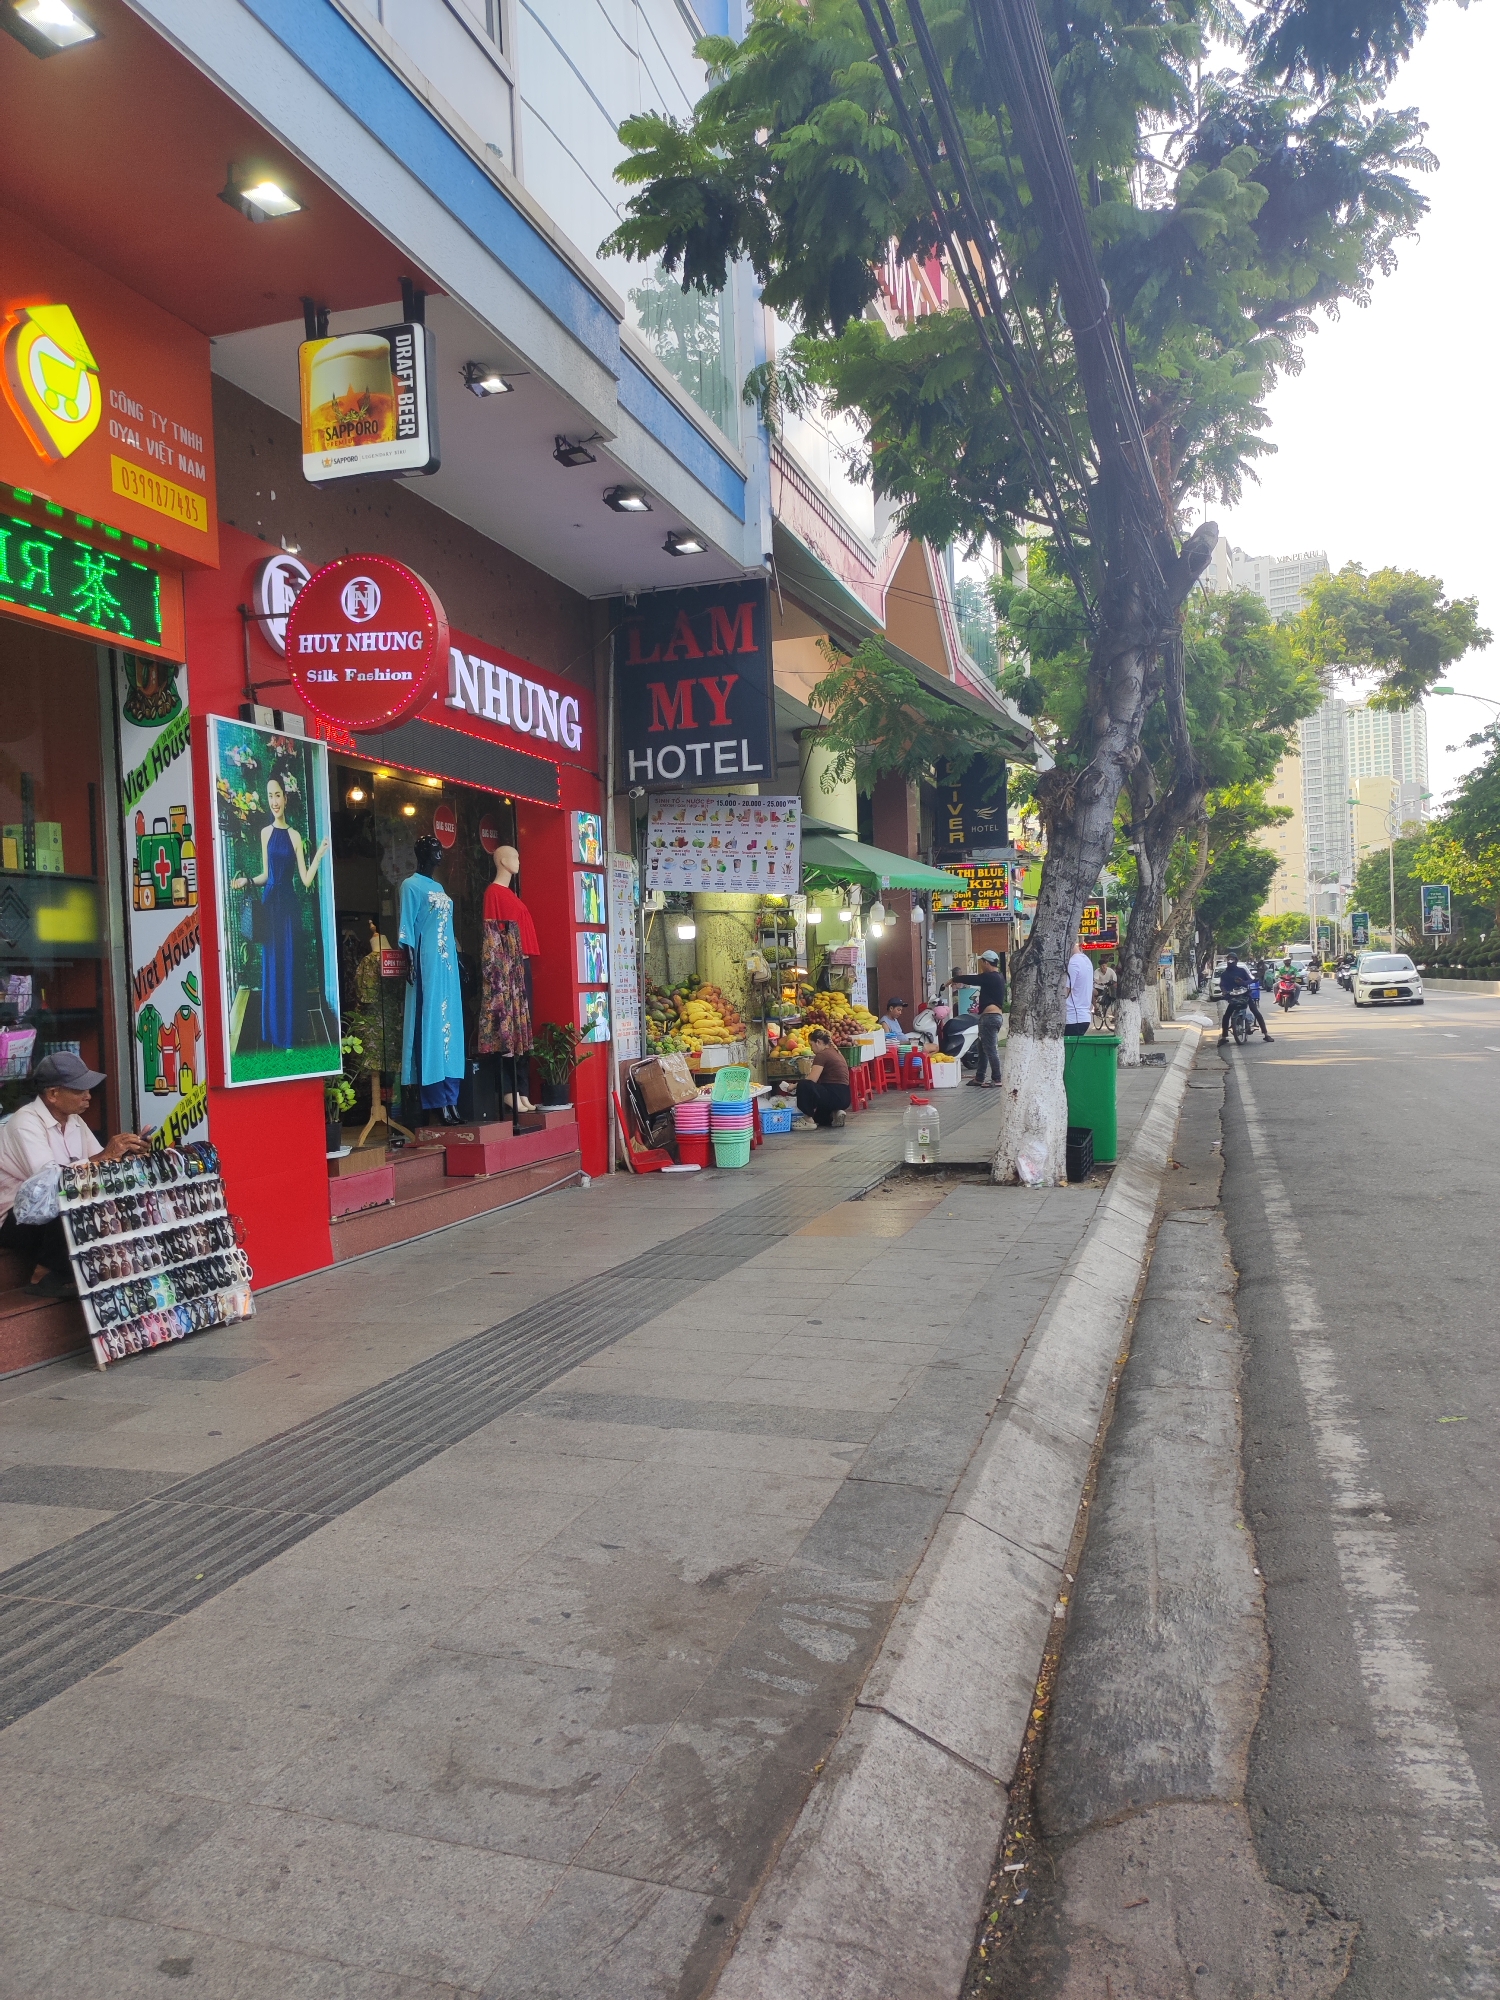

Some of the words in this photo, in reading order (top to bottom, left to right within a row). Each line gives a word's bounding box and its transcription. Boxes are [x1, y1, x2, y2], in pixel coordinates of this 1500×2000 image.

[395, 333, 414, 388] DRAFT
[109, 389, 145, 422] CÔNG
[149, 409, 168, 434] TY
[171, 421, 203, 453] TNHH
[325, 420, 379, 442] SAPPORO
[398, 393, 416, 436] BEER
[146, 436, 175, 465] VIỆT
[178, 453, 206, 482] NAM
[327, 437, 356, 448] PREMIU
[333, 455, 359, 465] SAPPORO
[121, 465, 198, 523] 0399877485
[298, 634, 343, 654] HUY
[345, 631, 424, 652] NHUNG
[624, 602, 759, 666] LAM
[306, 668, 339, 683] Silk
[344, 668, 413, 682] Fashion
[447, 647, 583, 751] NHUNG
[646, 674, 739, 732] MY
[628, 739, 764, 782] HOTEL
[123, 760, 150, 805] Viet
[435, 820, 444, 831] BIG
[444, 822, 455, 833] SIZE
[481, 828, 490, 838] BIG
[489, 829, 499, 839] SIZE
[971, 824, 999, 833] HOTEL
[957, 868, 975, 880] THỊ
[977, 867, 1005, 878] BLUE
[978, 889, 1004, 898] CHEAP
[133, 964, 160, 1001] Viet
